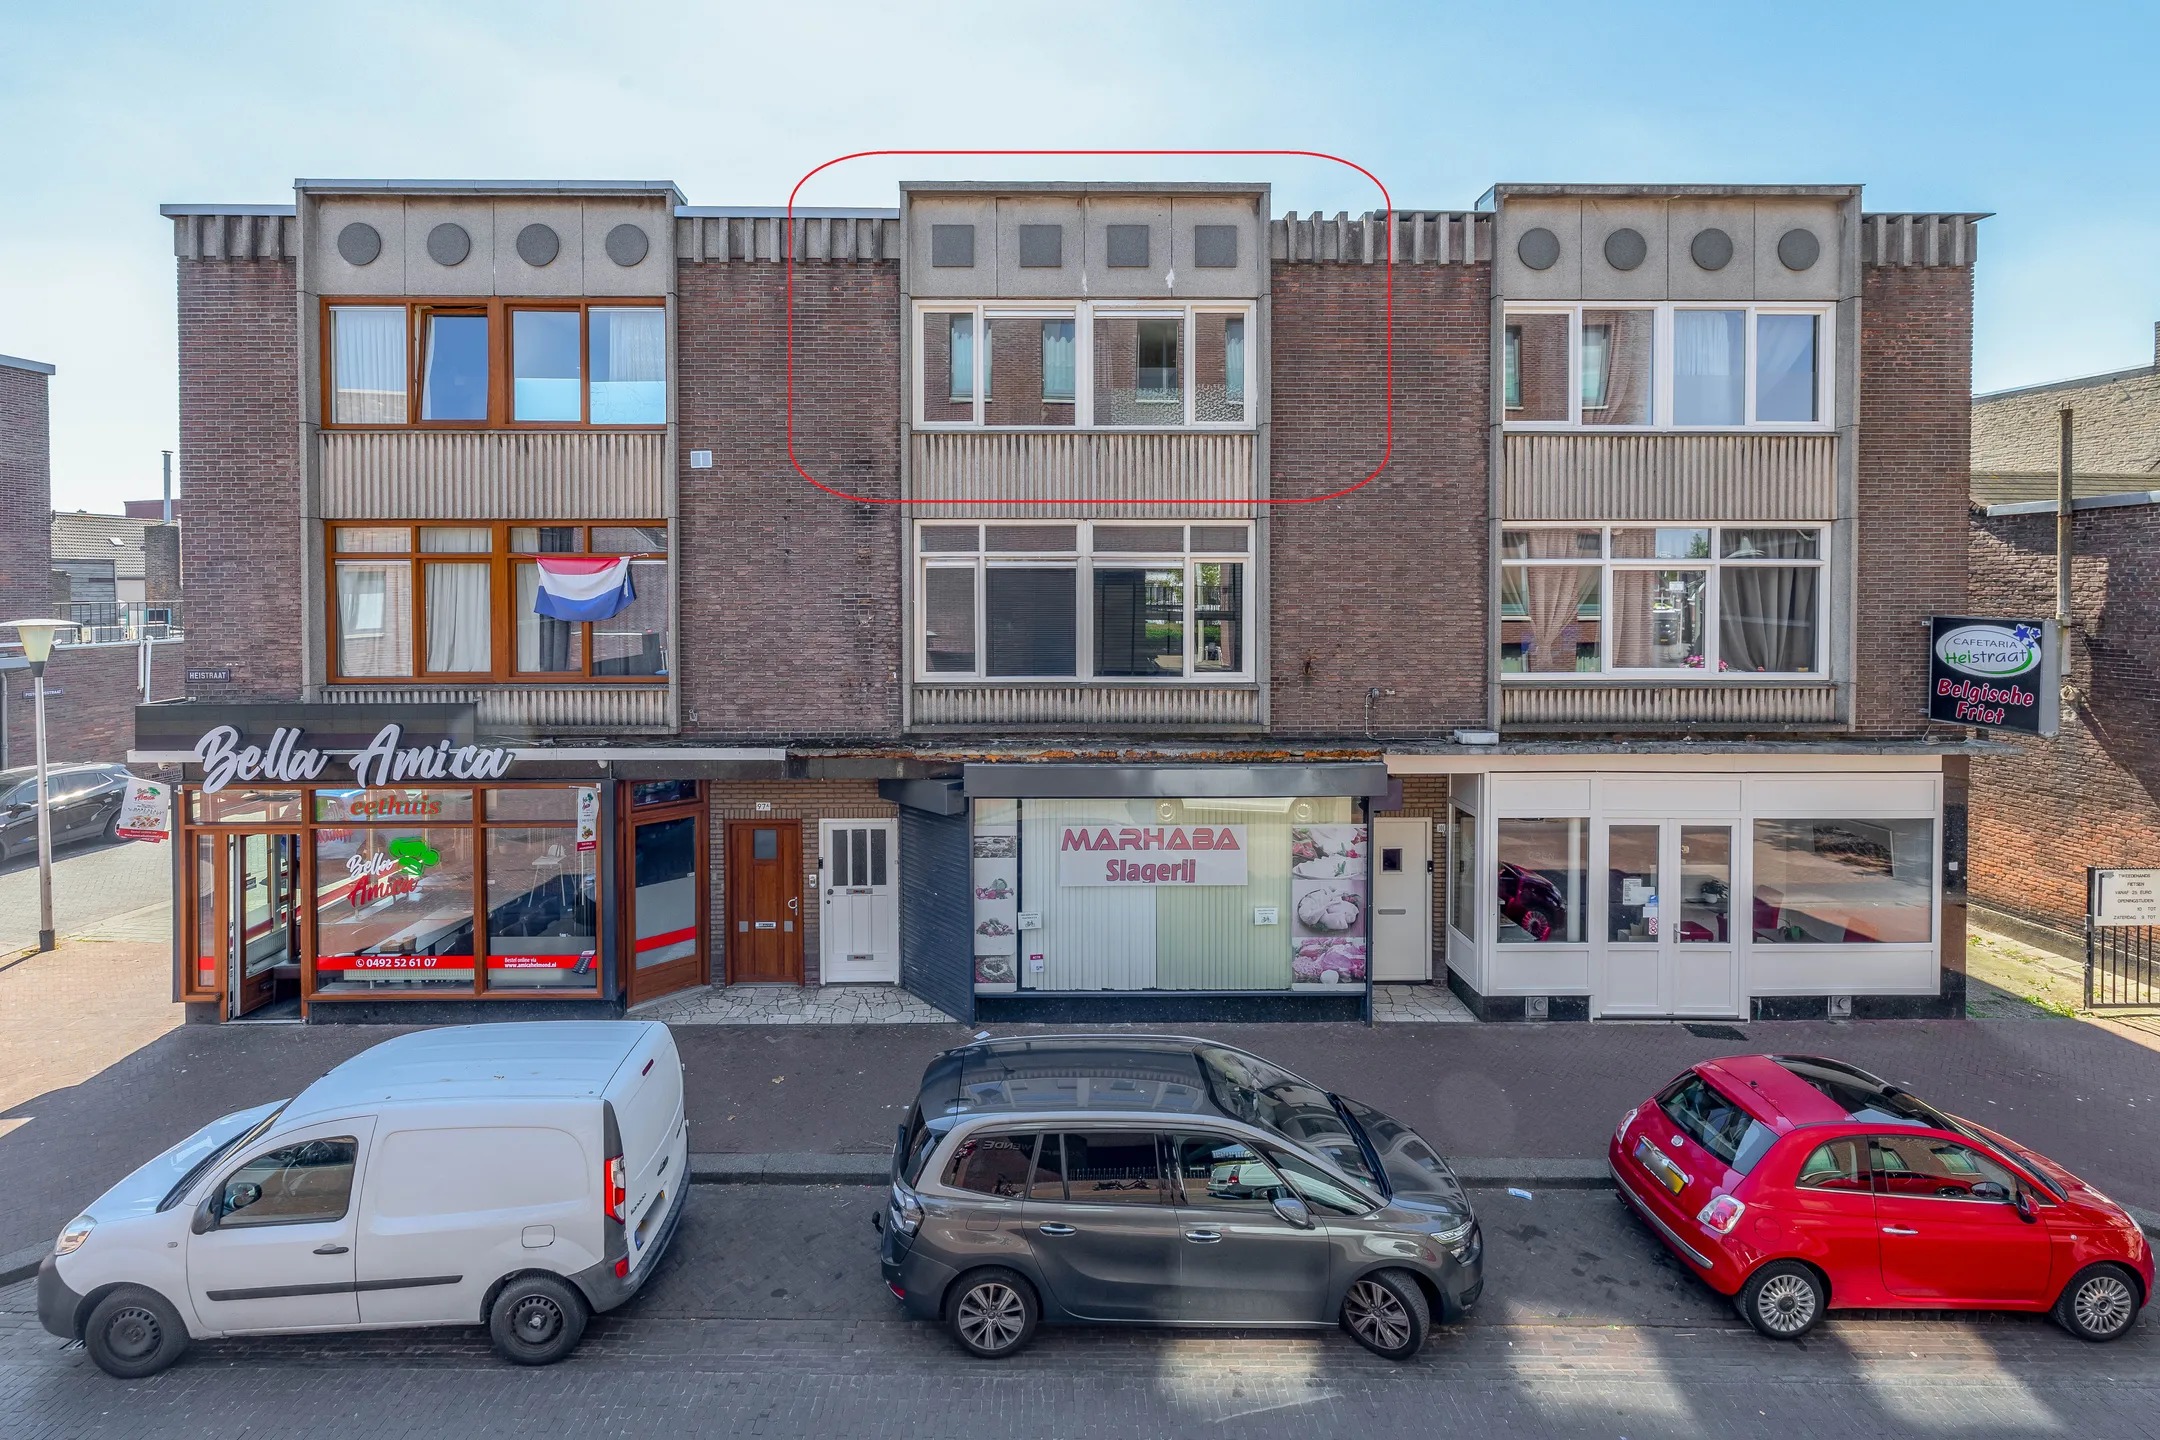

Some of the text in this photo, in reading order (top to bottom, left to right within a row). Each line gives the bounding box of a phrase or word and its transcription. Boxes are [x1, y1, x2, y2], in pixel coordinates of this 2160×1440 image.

[1953, 638, 2018, 649] CAFETARIA
[1945, 649, 2027, 664] Heistraat
[189, 671, 227, 680] HEISTRAAT
[1937, 678, 2034, 707] Belgische
[1956, 701, 2005, 725] Friet
[194, 723, 516, 794] Bella Amica
[350, 794, 441, 817] eethuis
[1061, 827, 1241, 851] MARHABA
[346, 853, 393, 880] Bella
[1105, 858, 1196, 884] Slagerij
[346, 874, 419, 908] Amica
[366, 958, 437, 967] 0492 52 61 07
